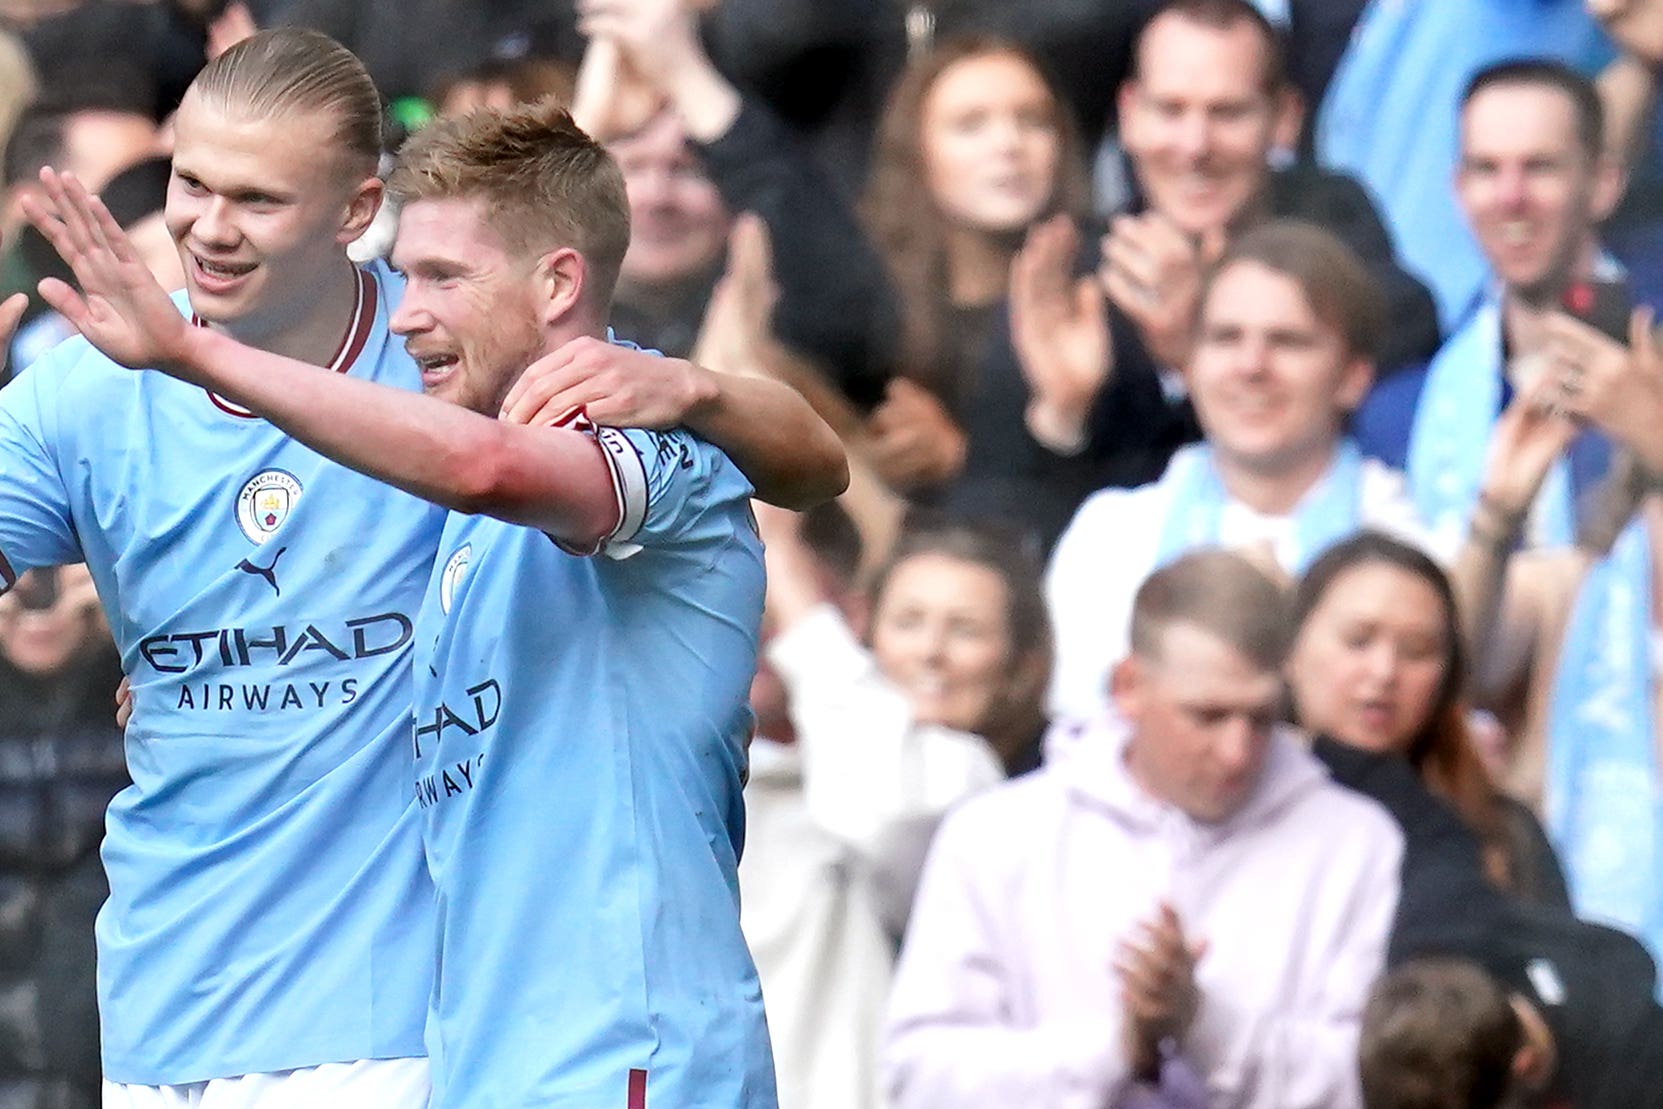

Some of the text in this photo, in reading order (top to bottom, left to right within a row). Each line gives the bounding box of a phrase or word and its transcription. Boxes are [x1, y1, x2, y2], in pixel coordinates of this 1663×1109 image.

[139, 611, 414, 674] ETIHAD
[177, 678, 359, 711] AIRWAYS
[412, 678, 501, 759] HAD
[415, 753, 485, 809] RWAY
